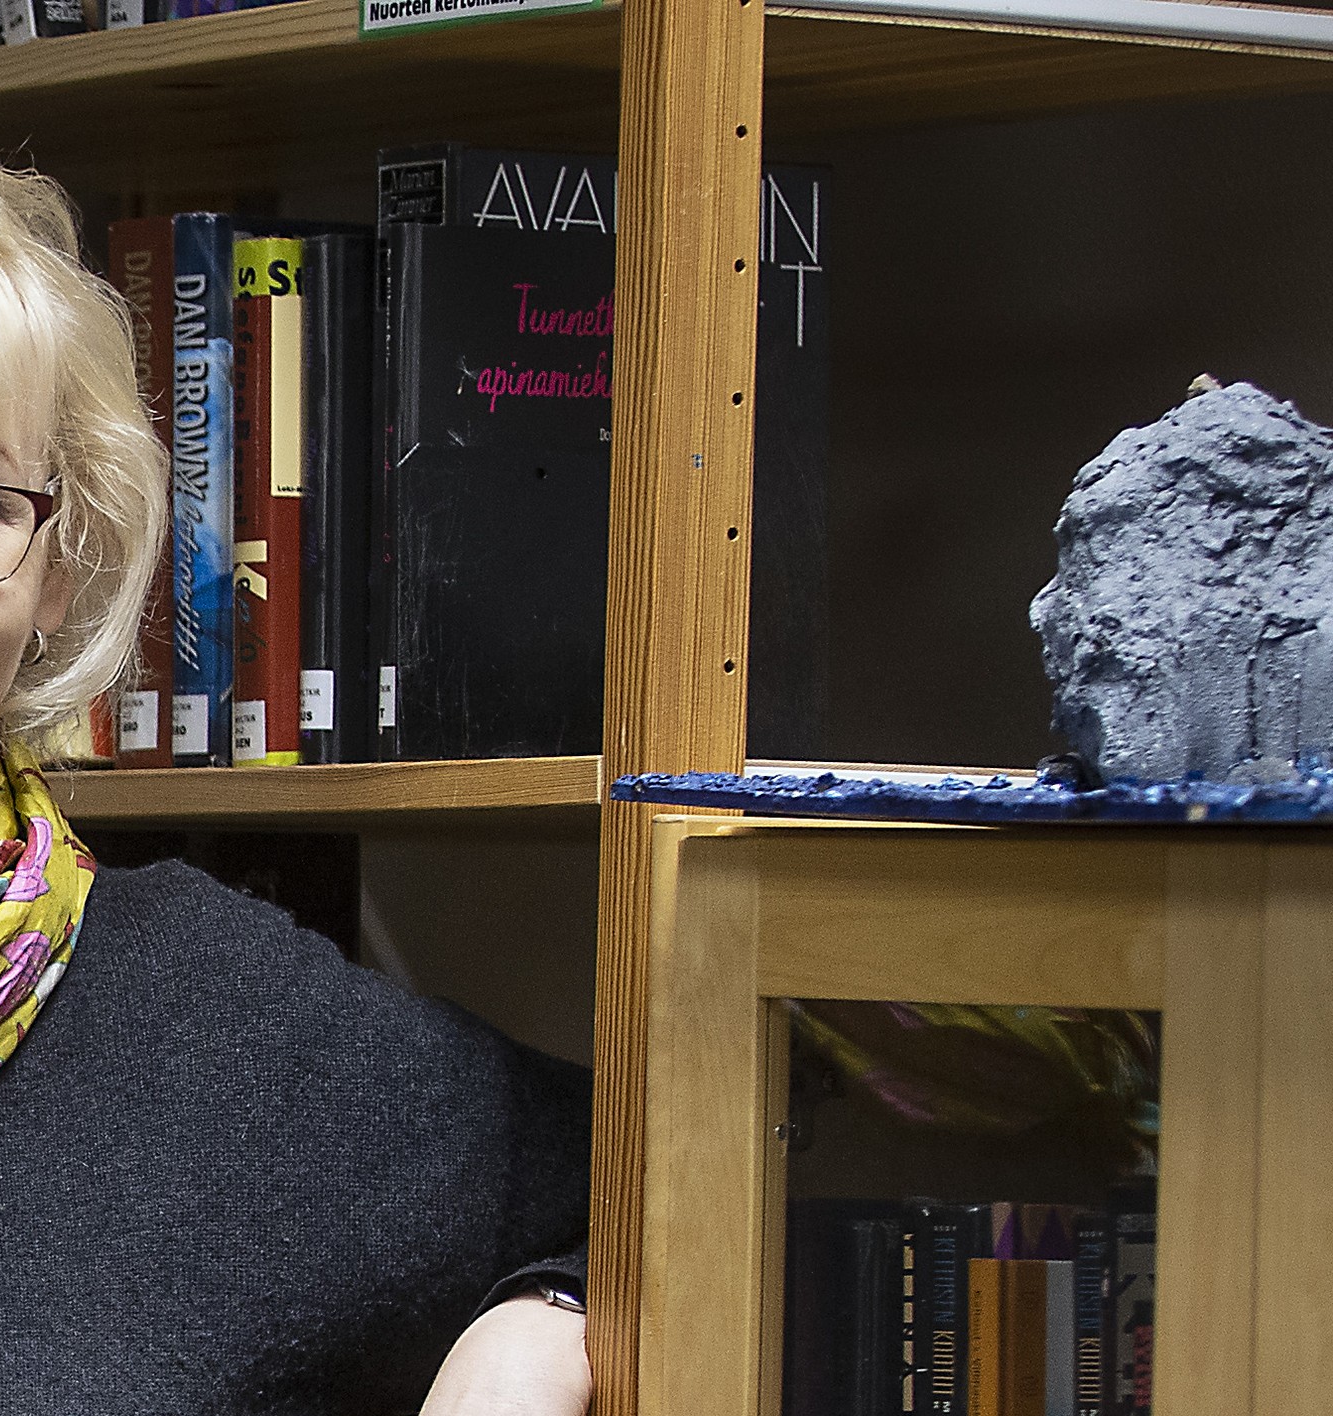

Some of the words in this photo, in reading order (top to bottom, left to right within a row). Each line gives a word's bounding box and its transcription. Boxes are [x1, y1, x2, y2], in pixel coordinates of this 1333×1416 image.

[369, 0, 431, 22] Nuorten
[173, 273, 207, 348] DAN
[173, 360, 208, 494] BROWN
